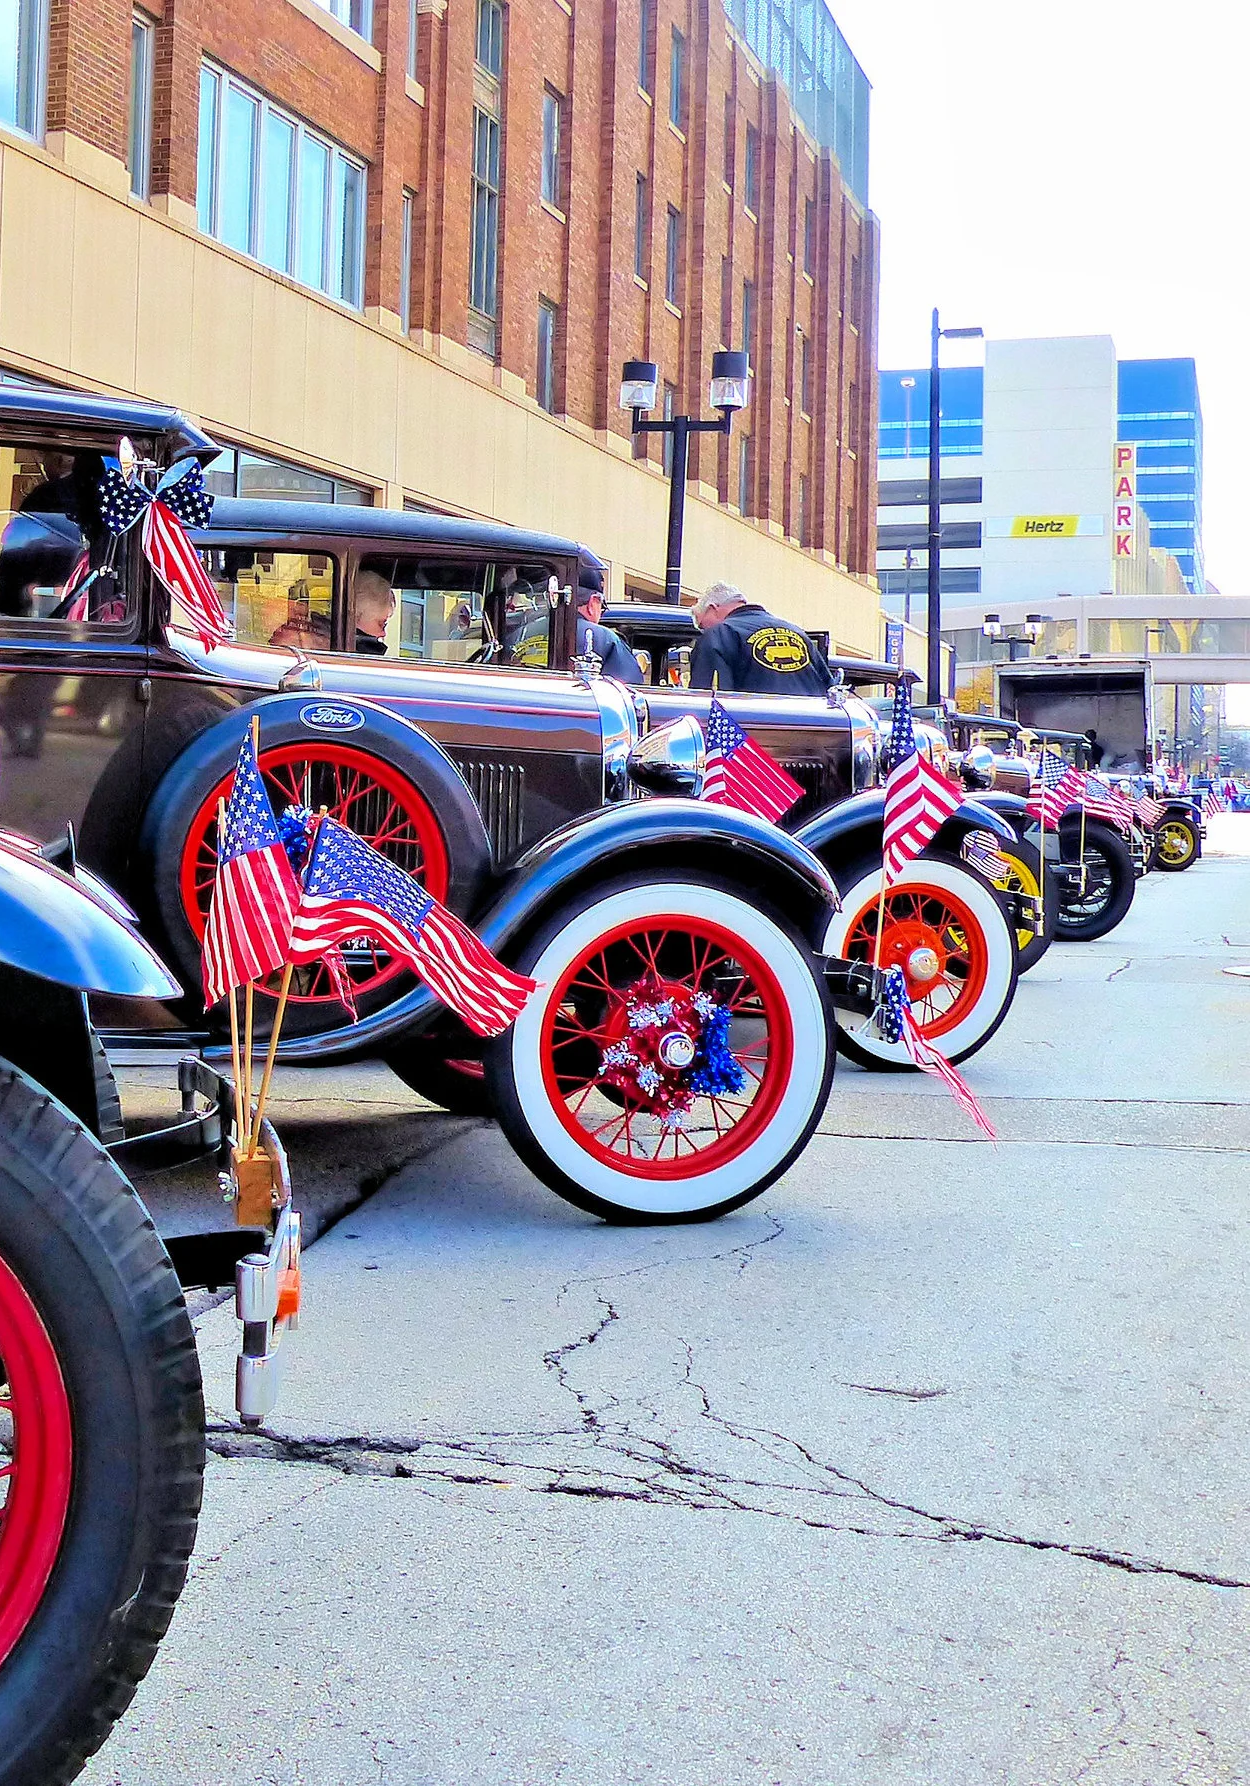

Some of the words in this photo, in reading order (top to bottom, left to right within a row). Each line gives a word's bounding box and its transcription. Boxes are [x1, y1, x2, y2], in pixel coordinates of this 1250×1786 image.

[1116, 448, 1133, 555] PARK
[1025, 521, 1064, 533] Hertz
[311, 707, 353, 724] Ford
